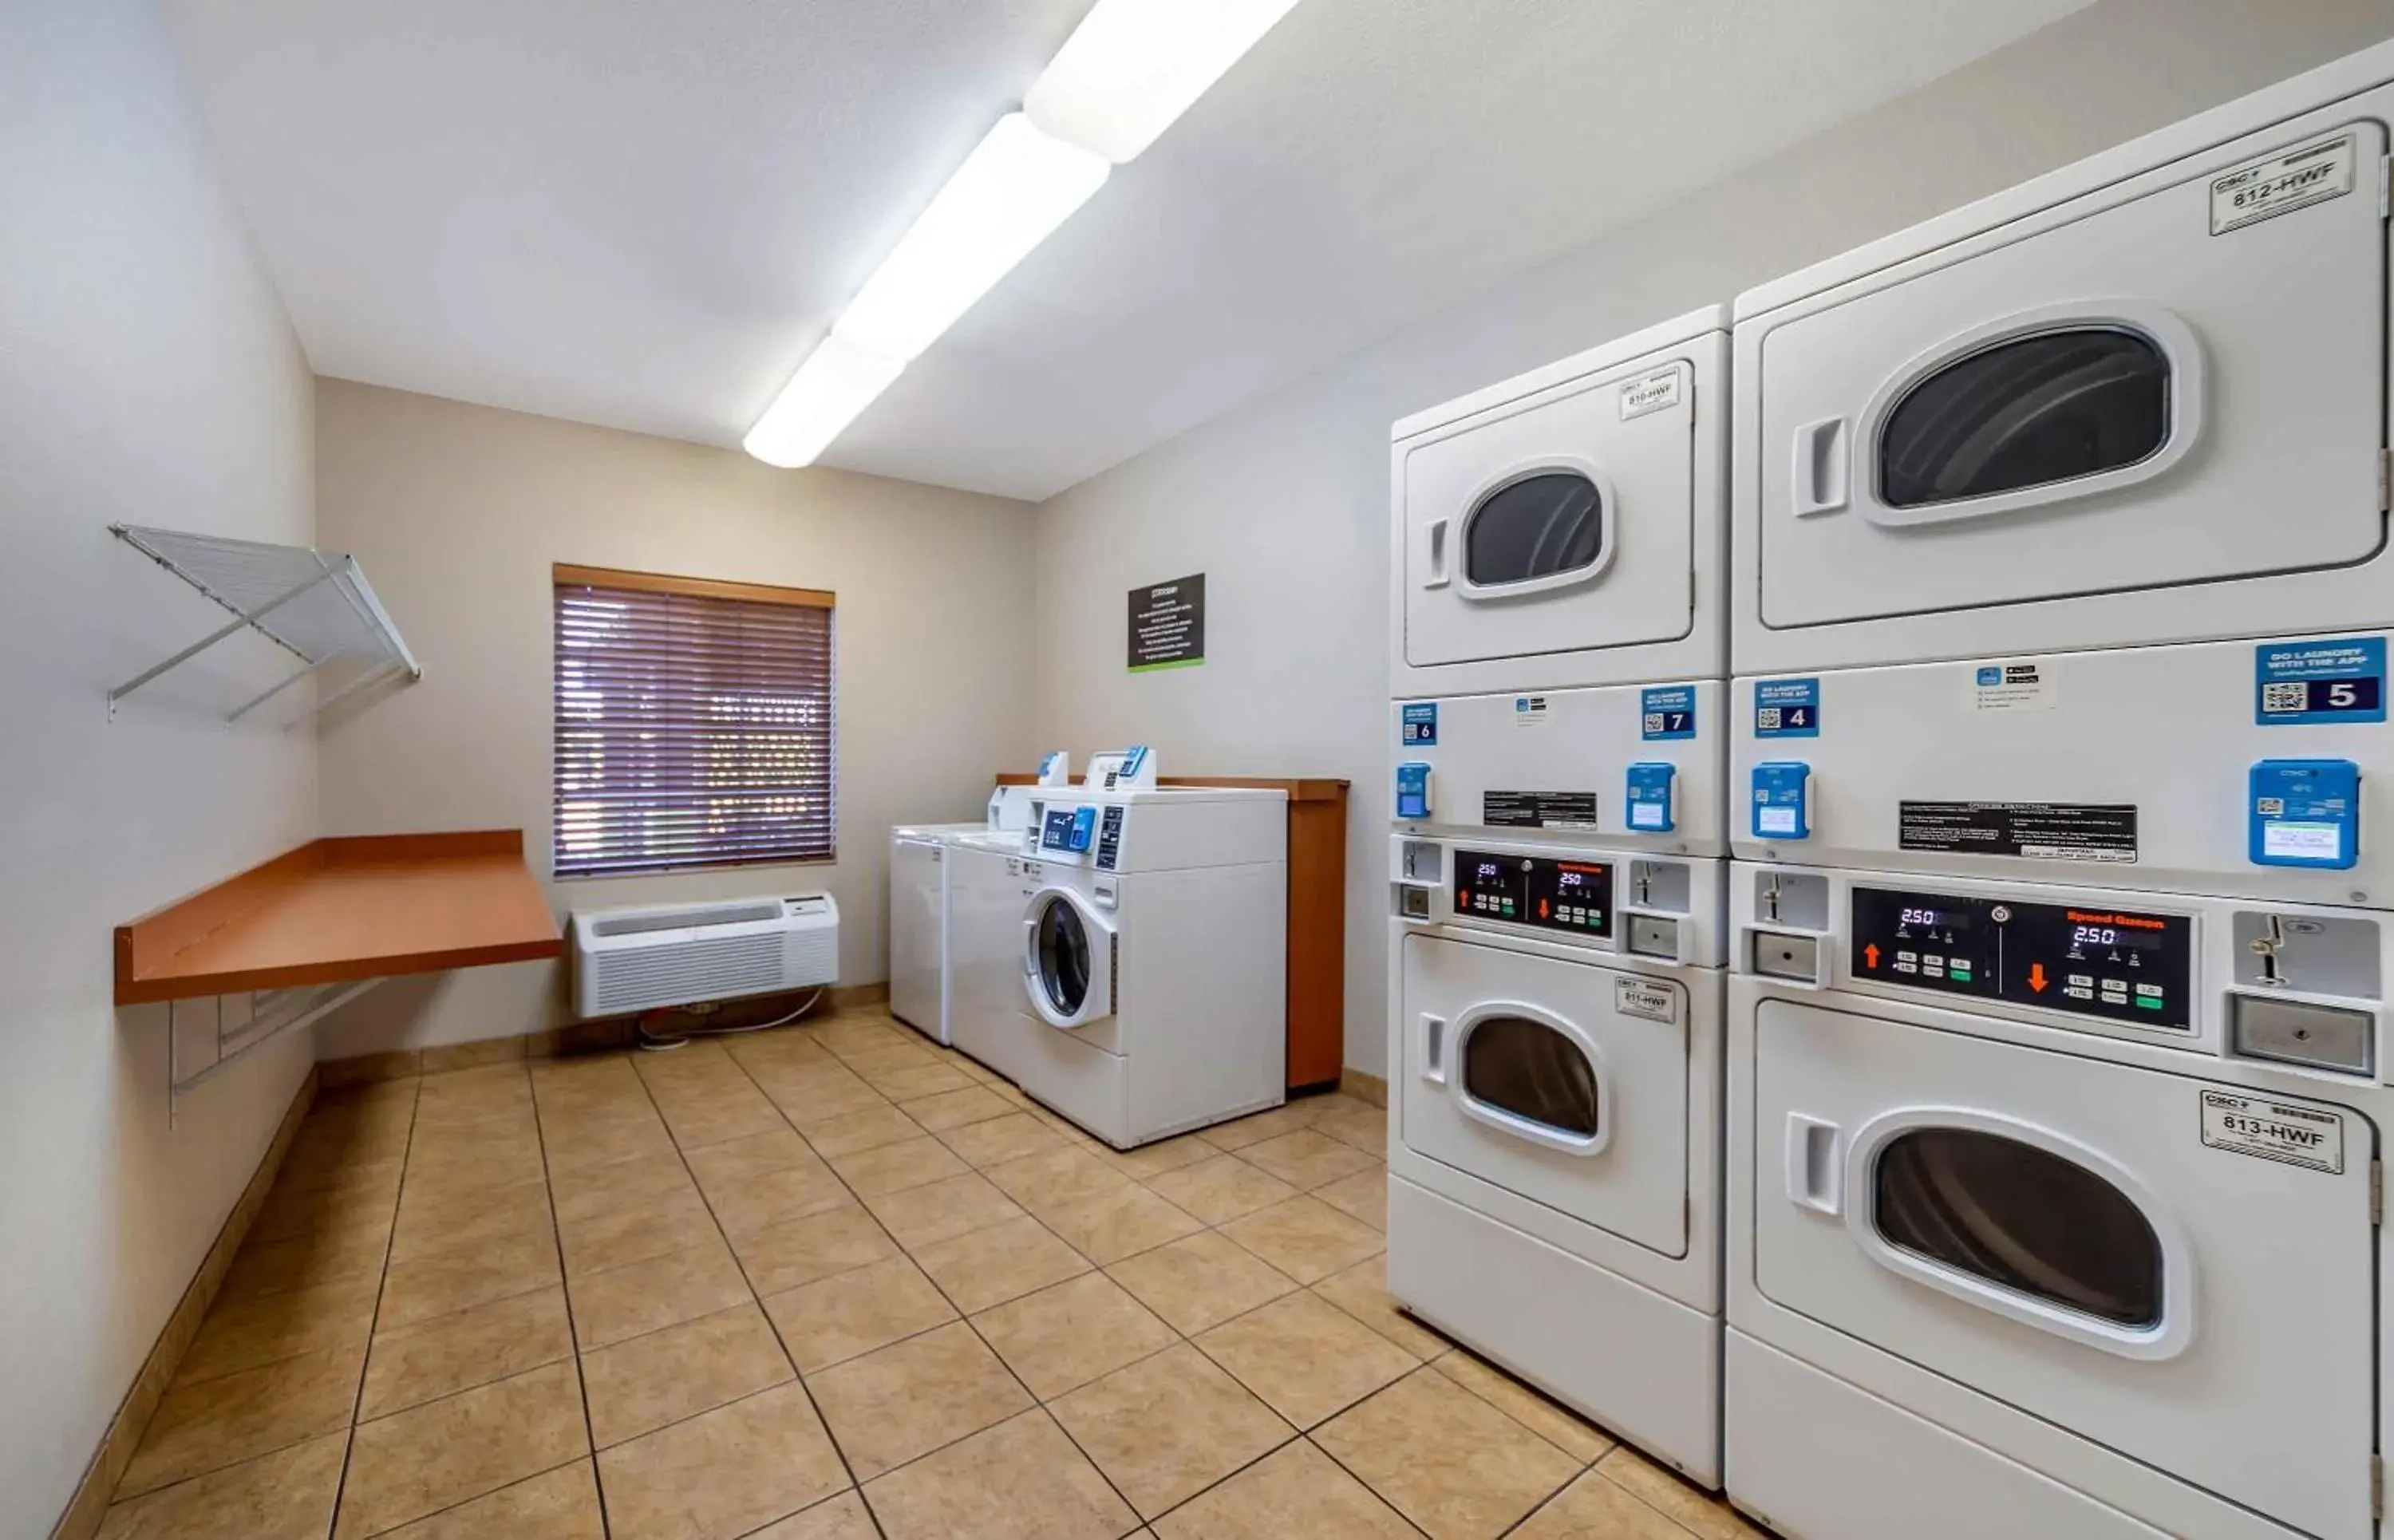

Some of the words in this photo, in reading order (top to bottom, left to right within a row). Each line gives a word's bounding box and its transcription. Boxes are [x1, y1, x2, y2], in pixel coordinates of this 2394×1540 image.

[2233, 161, 2337, 207] 812-HWF
[2328, 684, 2356, 707] 5
[1672, 714, 1683, 730] 7
[1790, 709, 1806, 725] 4
[1421, 725, 1430, 737] 6
[1902, 909, 1934, 925] 2.50
[2067, 911, 2112, 923] Speed
[2114, 915, 2165, 929] Queen
[2074, 926, 2115, 944] 2.50
[2223, 1116, 2325, 1146] 813-HWF
